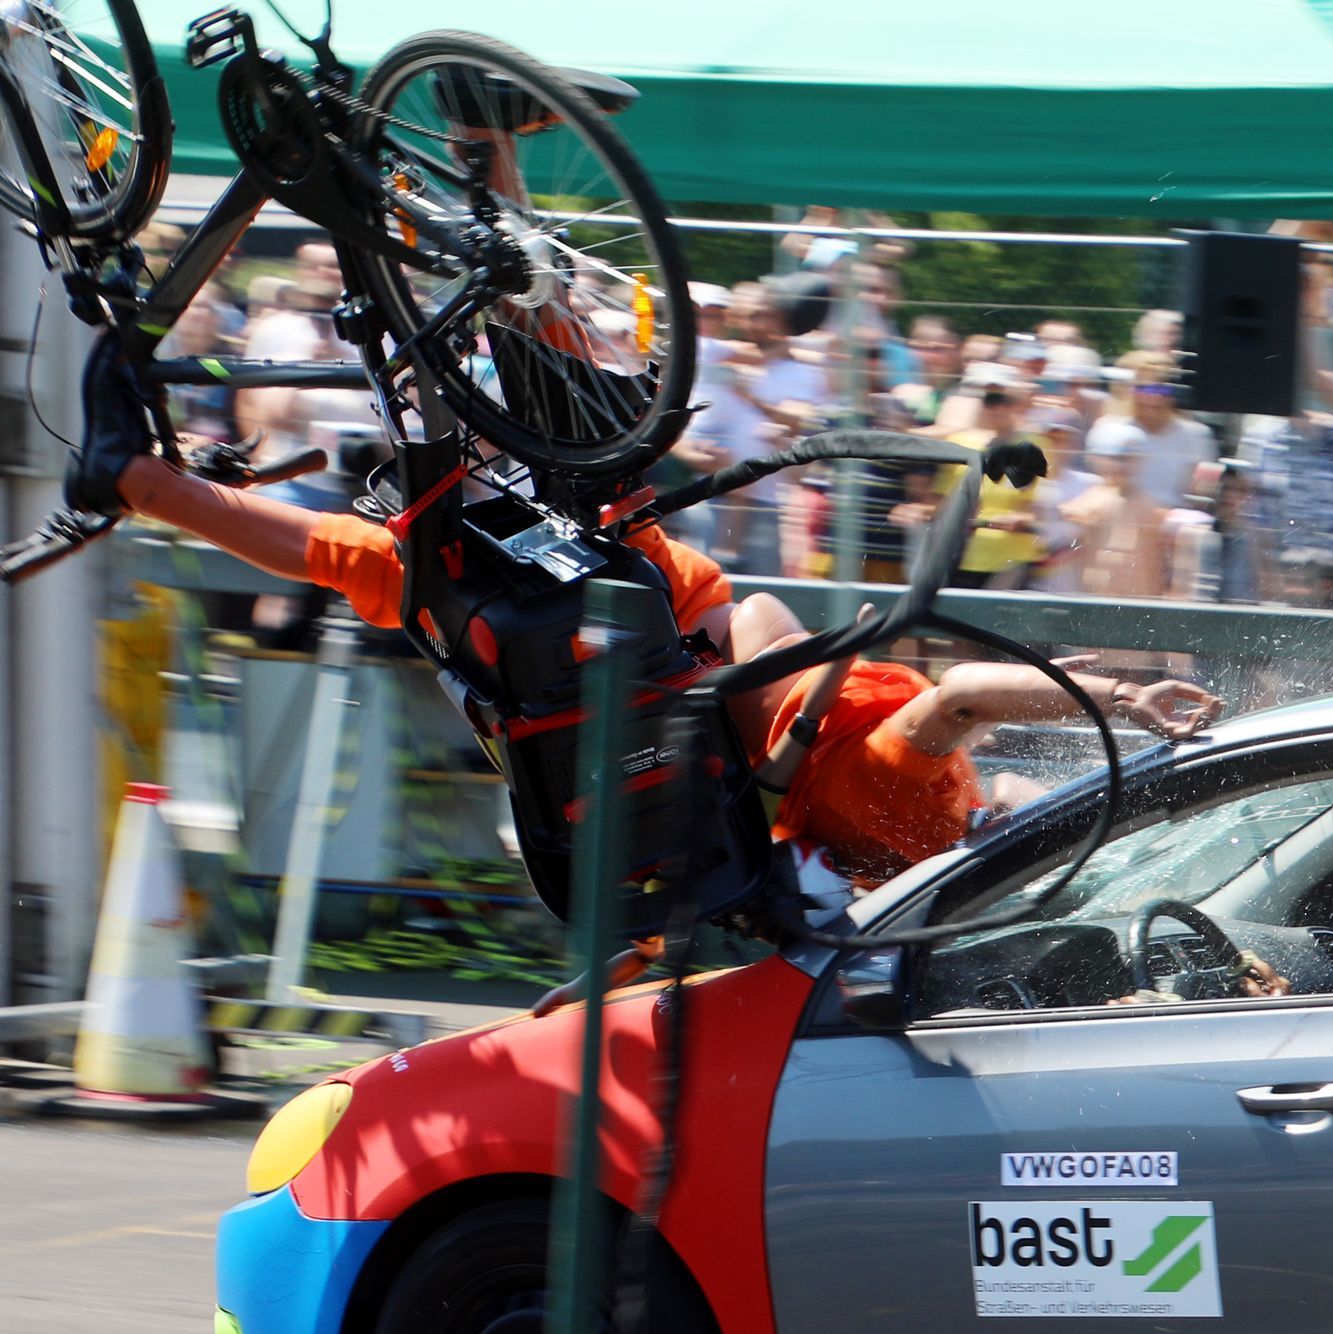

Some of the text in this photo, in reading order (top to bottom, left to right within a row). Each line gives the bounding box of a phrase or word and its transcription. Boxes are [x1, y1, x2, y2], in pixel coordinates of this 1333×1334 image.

[1008, 1155, 1172, 1178] VWGOFA08
[972, 1203, 1113, 1267] bast
[975, 1279, 1096, 1293] Bundesanstalt für
[976, 1300, 1175, 1314] Straßen- und Verkehrswesen
